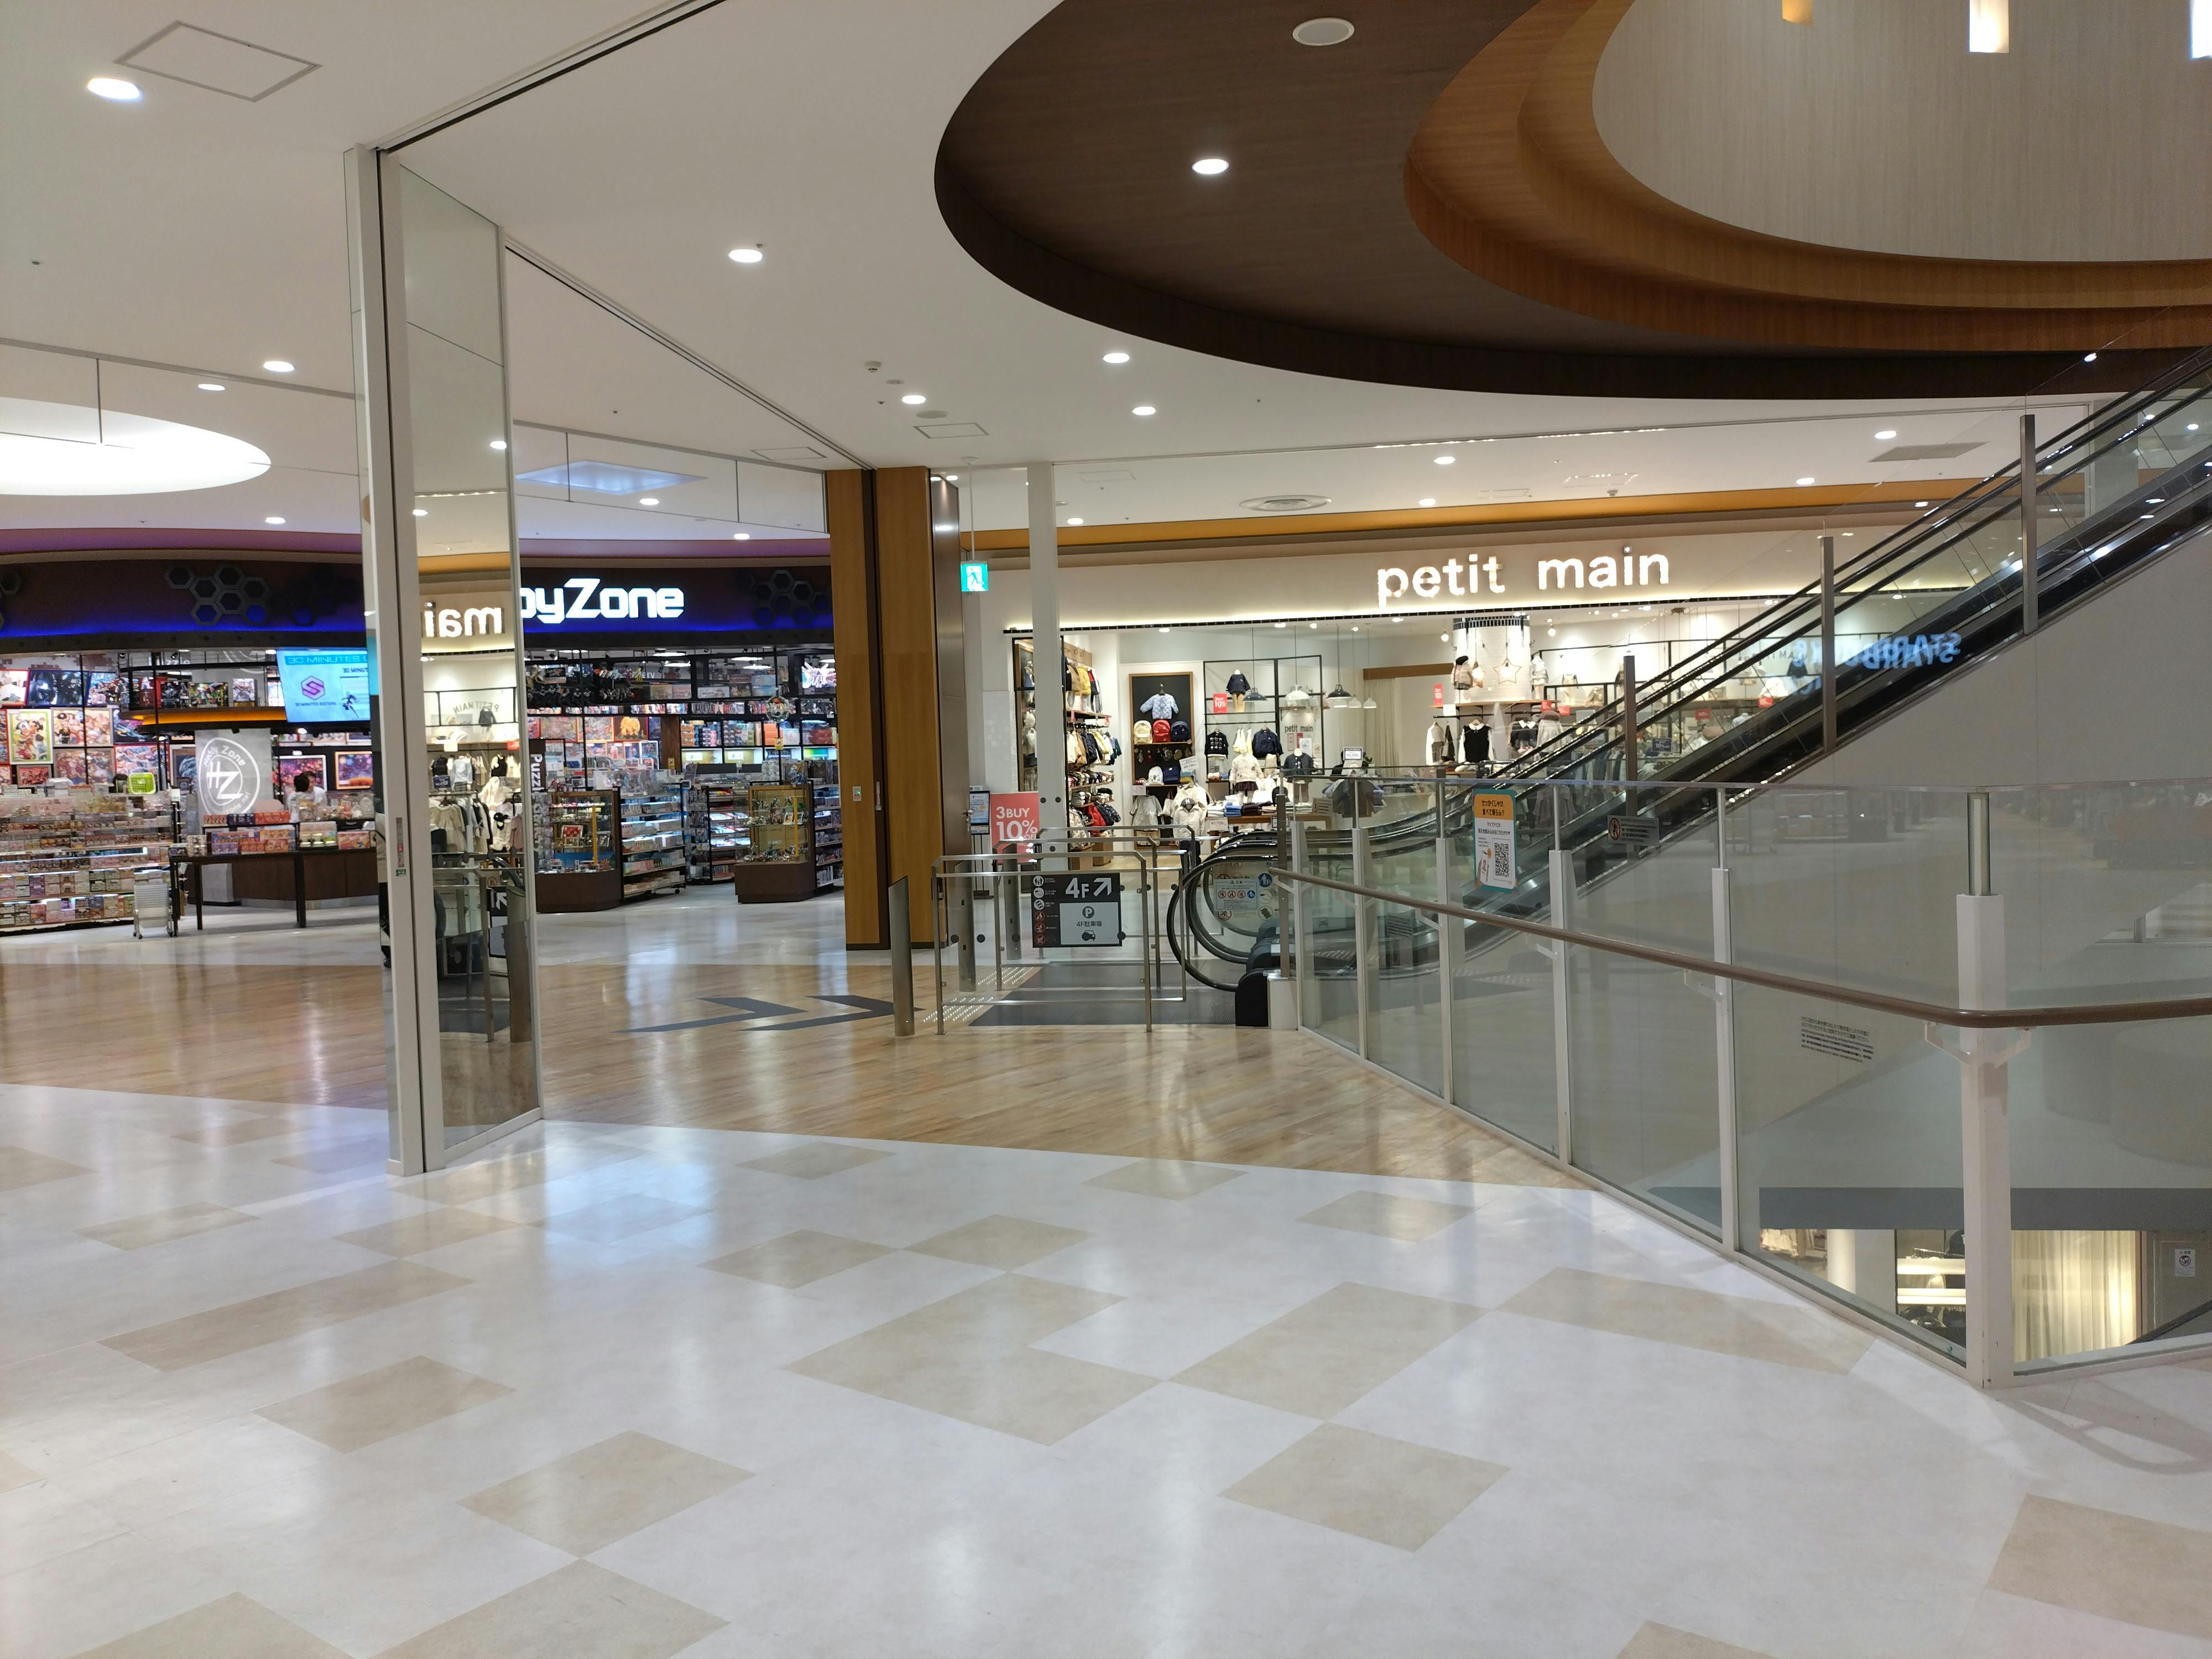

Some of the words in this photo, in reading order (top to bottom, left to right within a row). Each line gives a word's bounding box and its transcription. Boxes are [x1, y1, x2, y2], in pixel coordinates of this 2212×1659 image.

[1378, 553, 1505, 608] petit
[1538, 545, 1669, 589] main
[1285, 724, 1298, 733] petit
[1300, 724, 1313, 732] main
[530, 754, 547, 796] Puzzl
[996, 806, 1030, 819] 3BUY
[996, 820, 1038, 841] 10%
[1065, 877, 1089, 898] 4F
